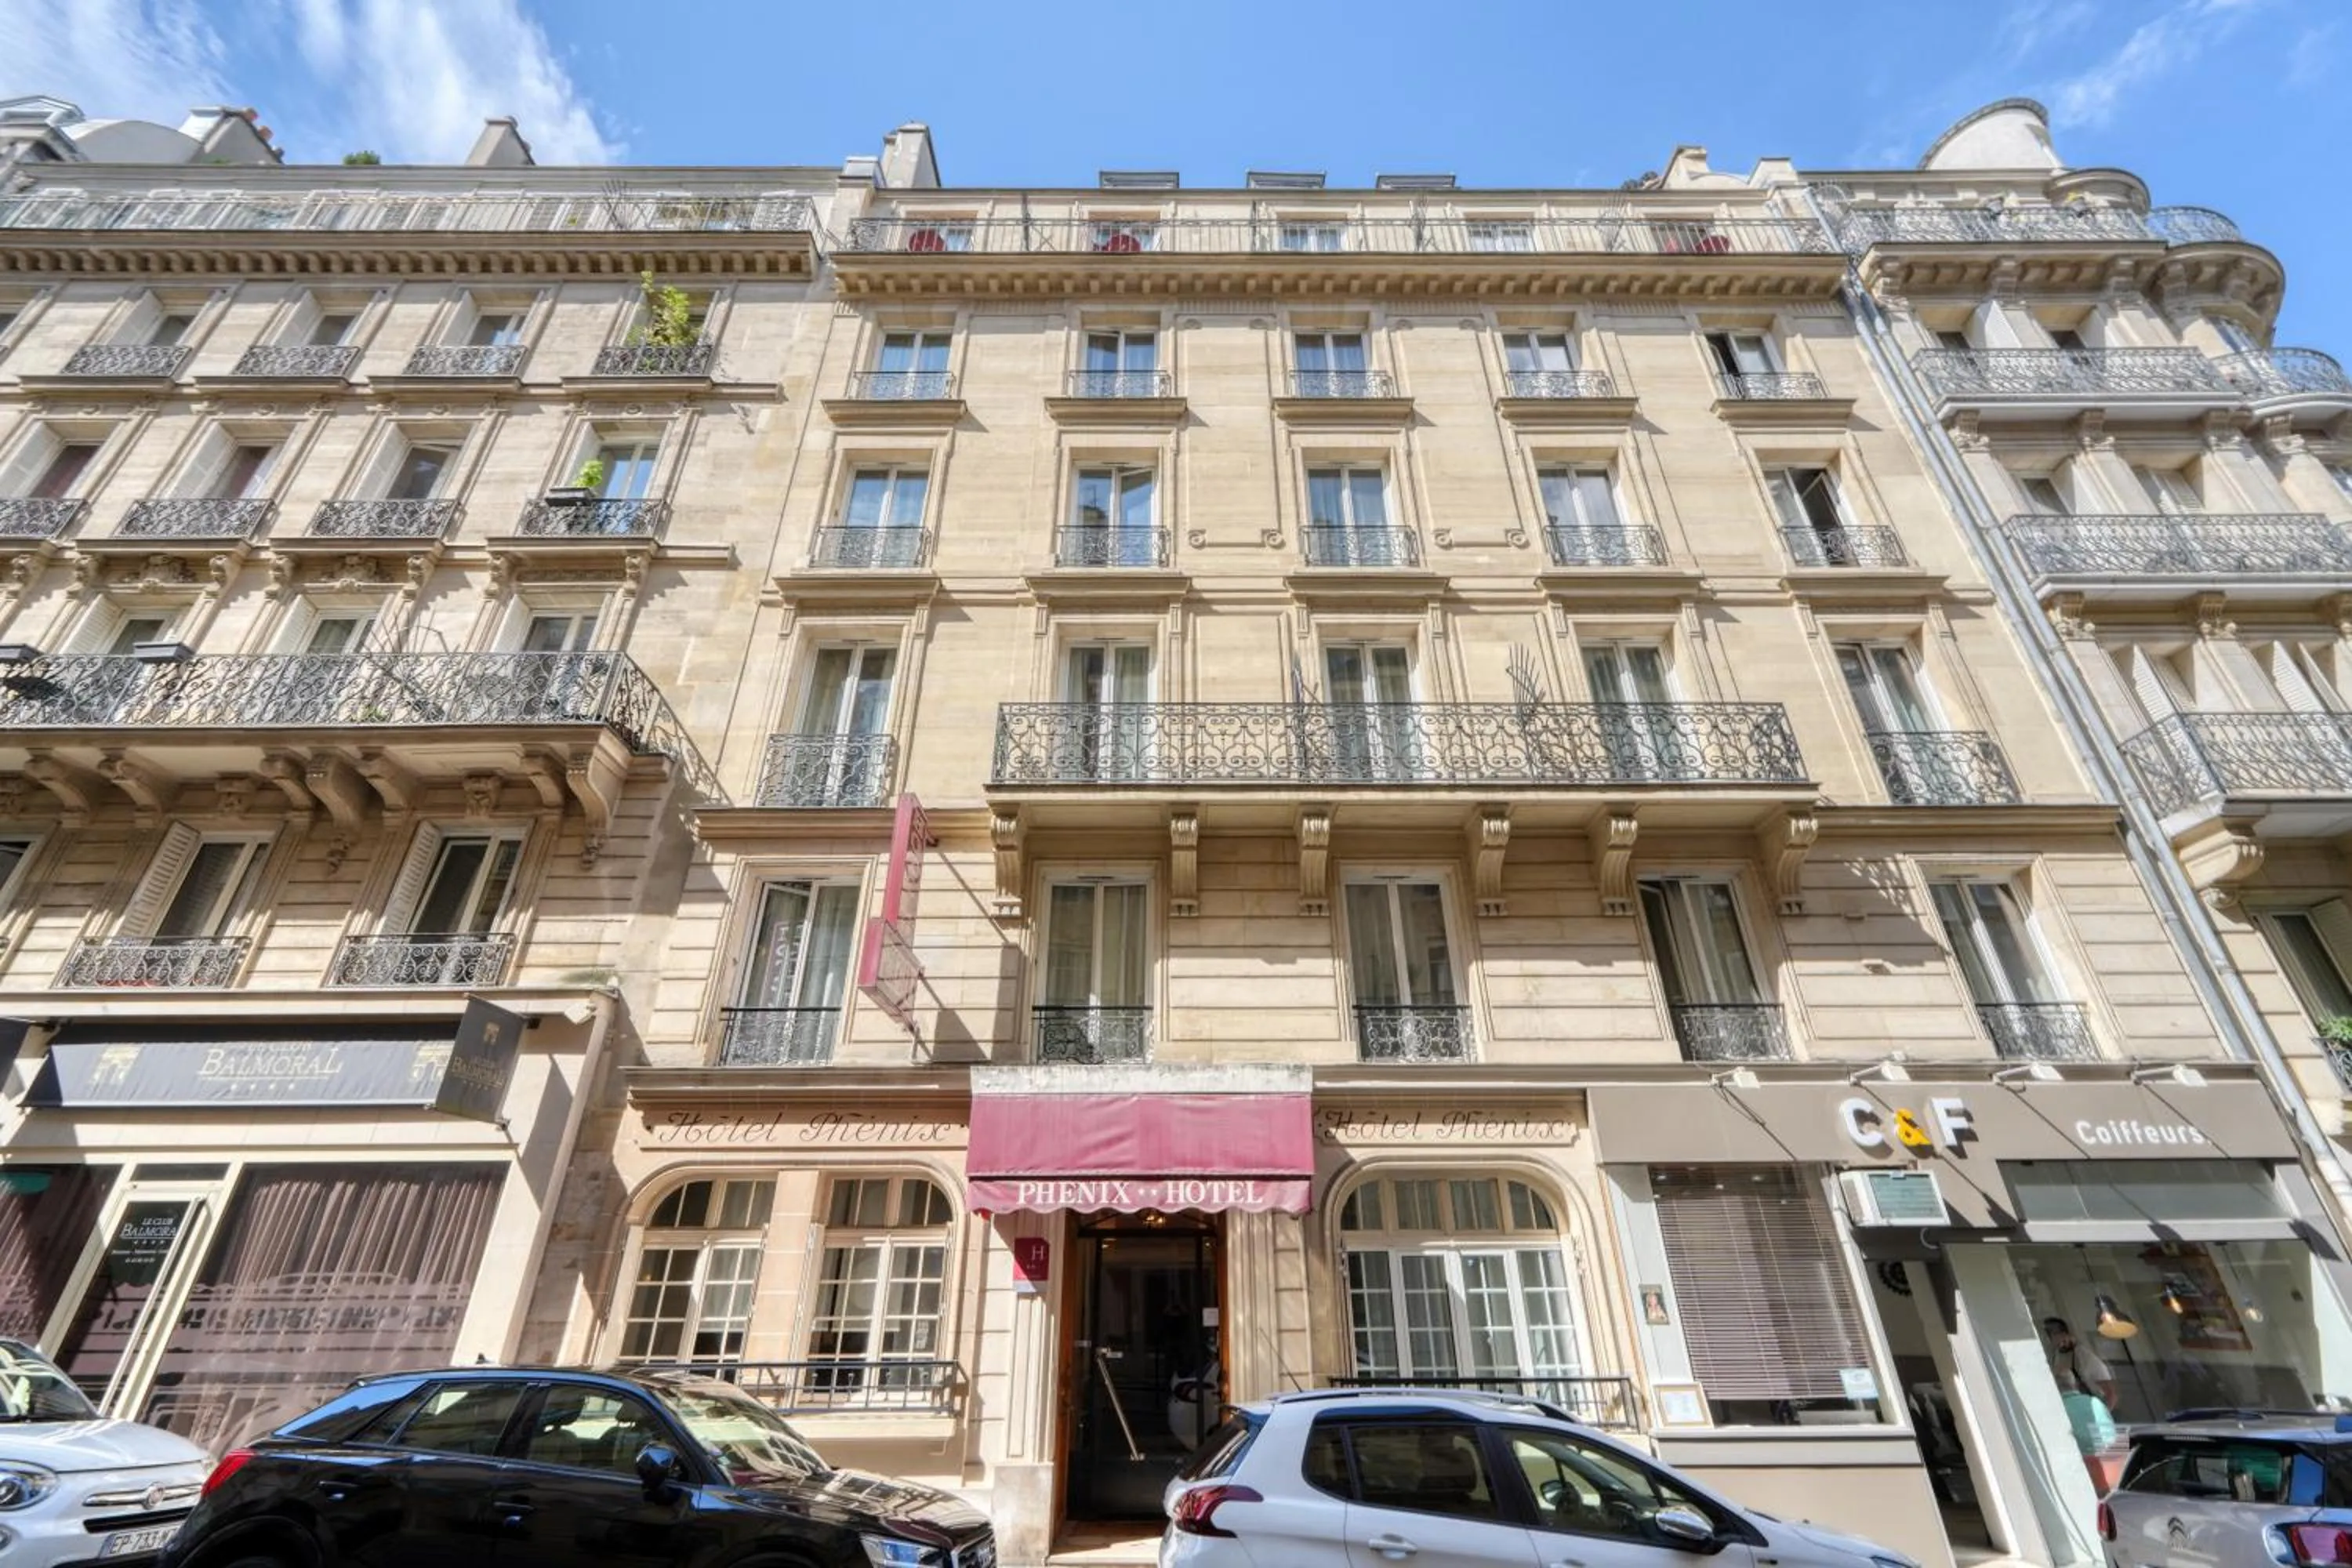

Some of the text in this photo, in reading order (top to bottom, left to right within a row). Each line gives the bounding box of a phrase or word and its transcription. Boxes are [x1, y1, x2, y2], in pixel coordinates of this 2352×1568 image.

[198, 1047, 343, 1076] BALMORAL
[1015, 1180, 1263, 1206] PHENIX HOTEL
[119, 1223, 178, 1238] BALMORA
[1031, 1244, 1044, 1261] H
